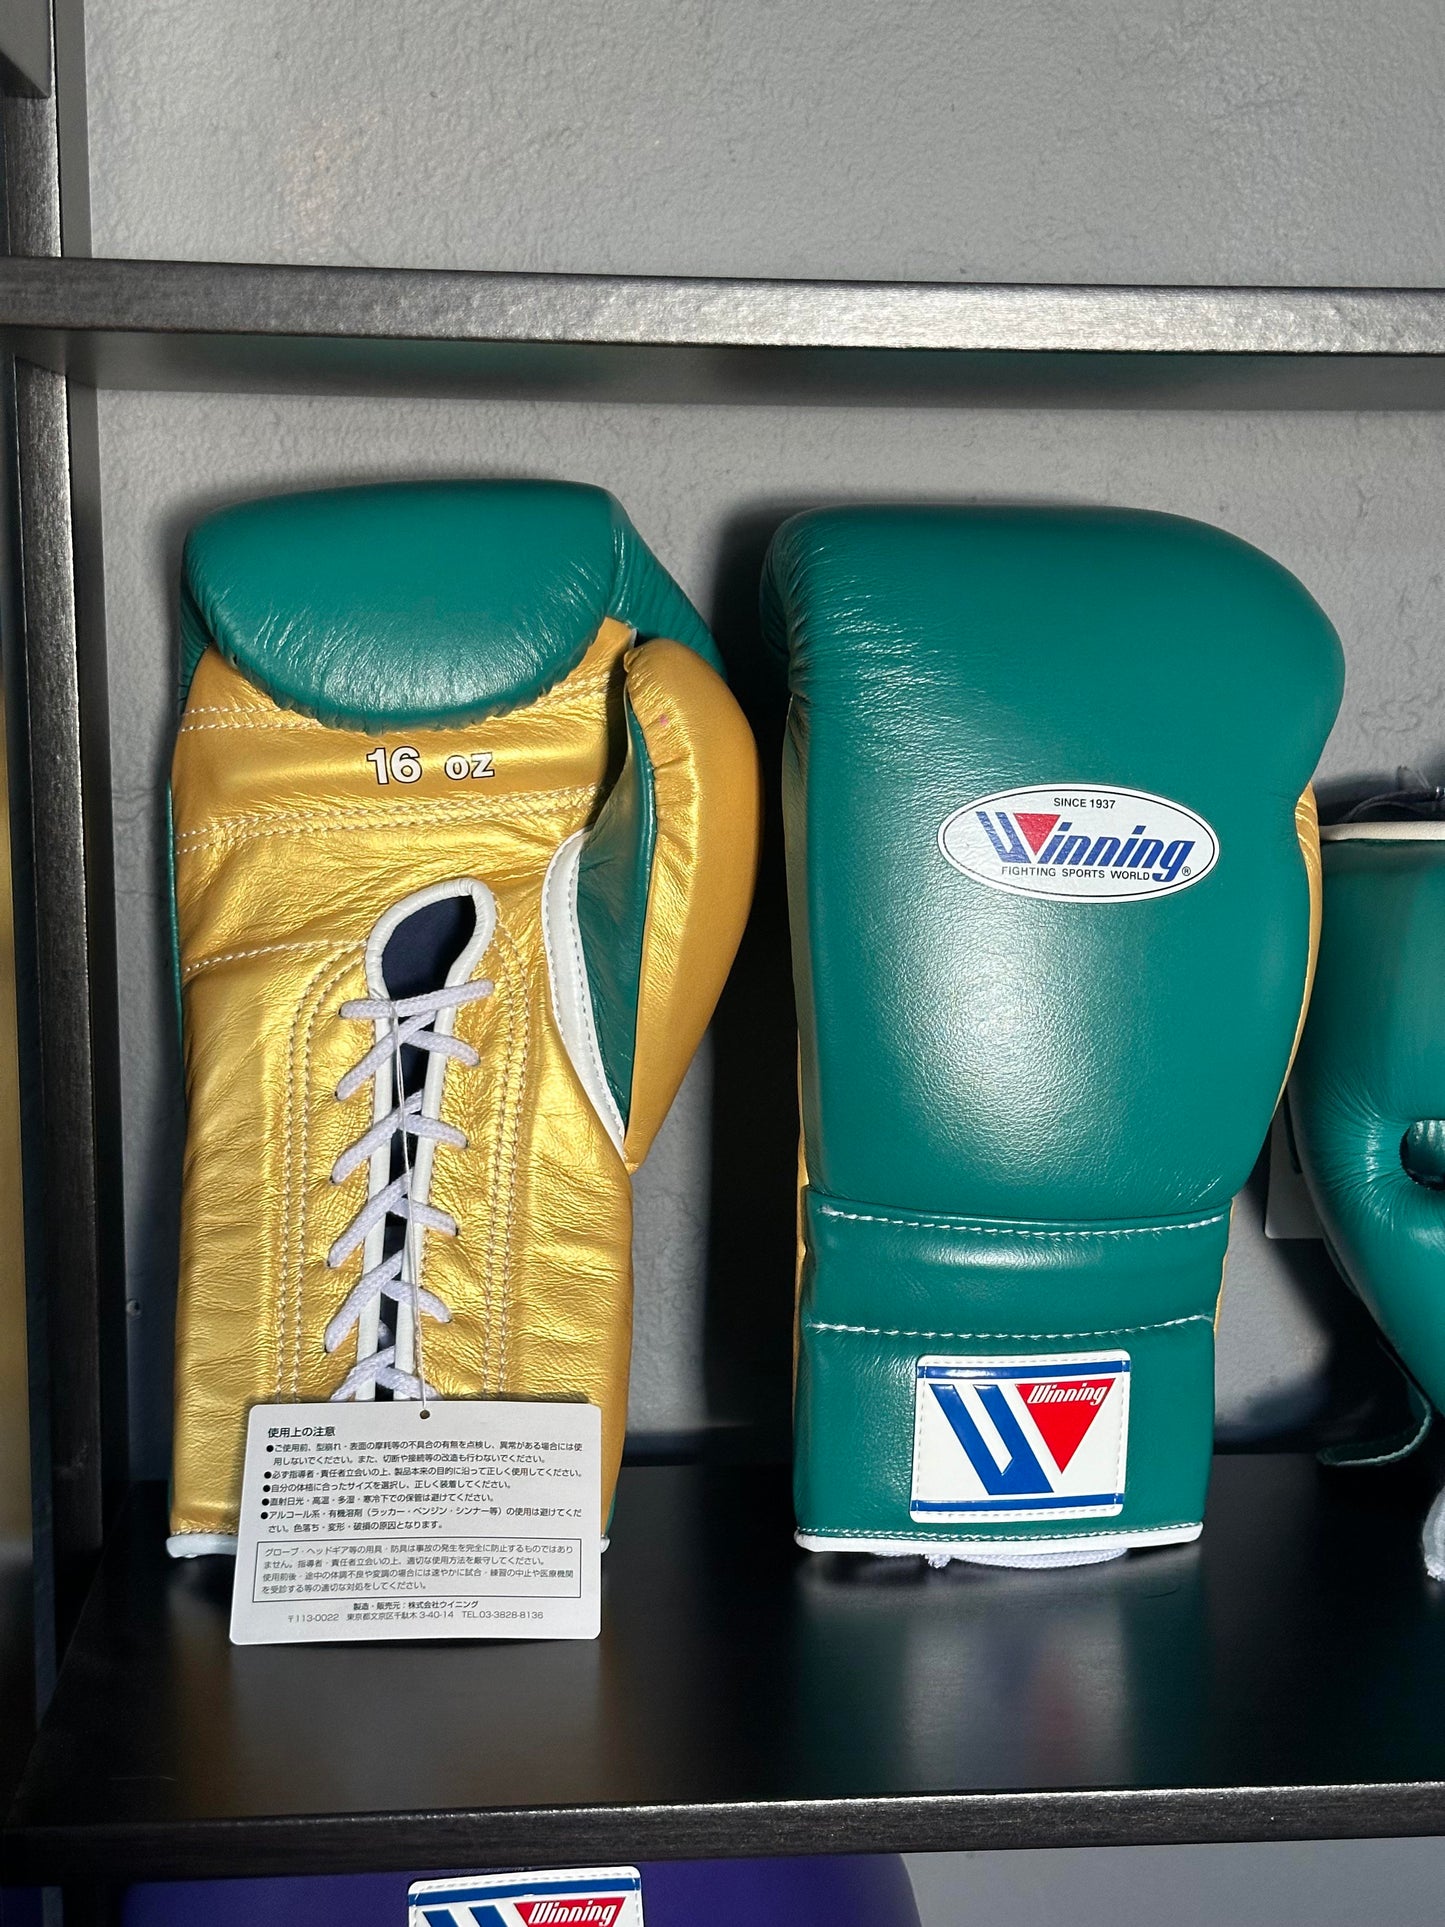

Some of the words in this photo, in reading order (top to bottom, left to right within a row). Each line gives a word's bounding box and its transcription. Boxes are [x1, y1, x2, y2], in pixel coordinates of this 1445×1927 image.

[366, 745, 422, 785] 16
[444, 752, 495, 780] oz
[1053, 797, 1087, 808] SINCE
[1089, 799, 1116, 809] 1937
[975, 811, 1196, 882] Winning
[1001, 866, 1056, 877] FIGHTING
[1062, 868, 1105, 879] SPORTS
[1111, 870, 1150, 881] WORLD
[1027, 1383, 1108, 1406] Winning
[268, 1426, 337, 1438] 使用上の注意
[528, 1900, 617, 1927] Winning
